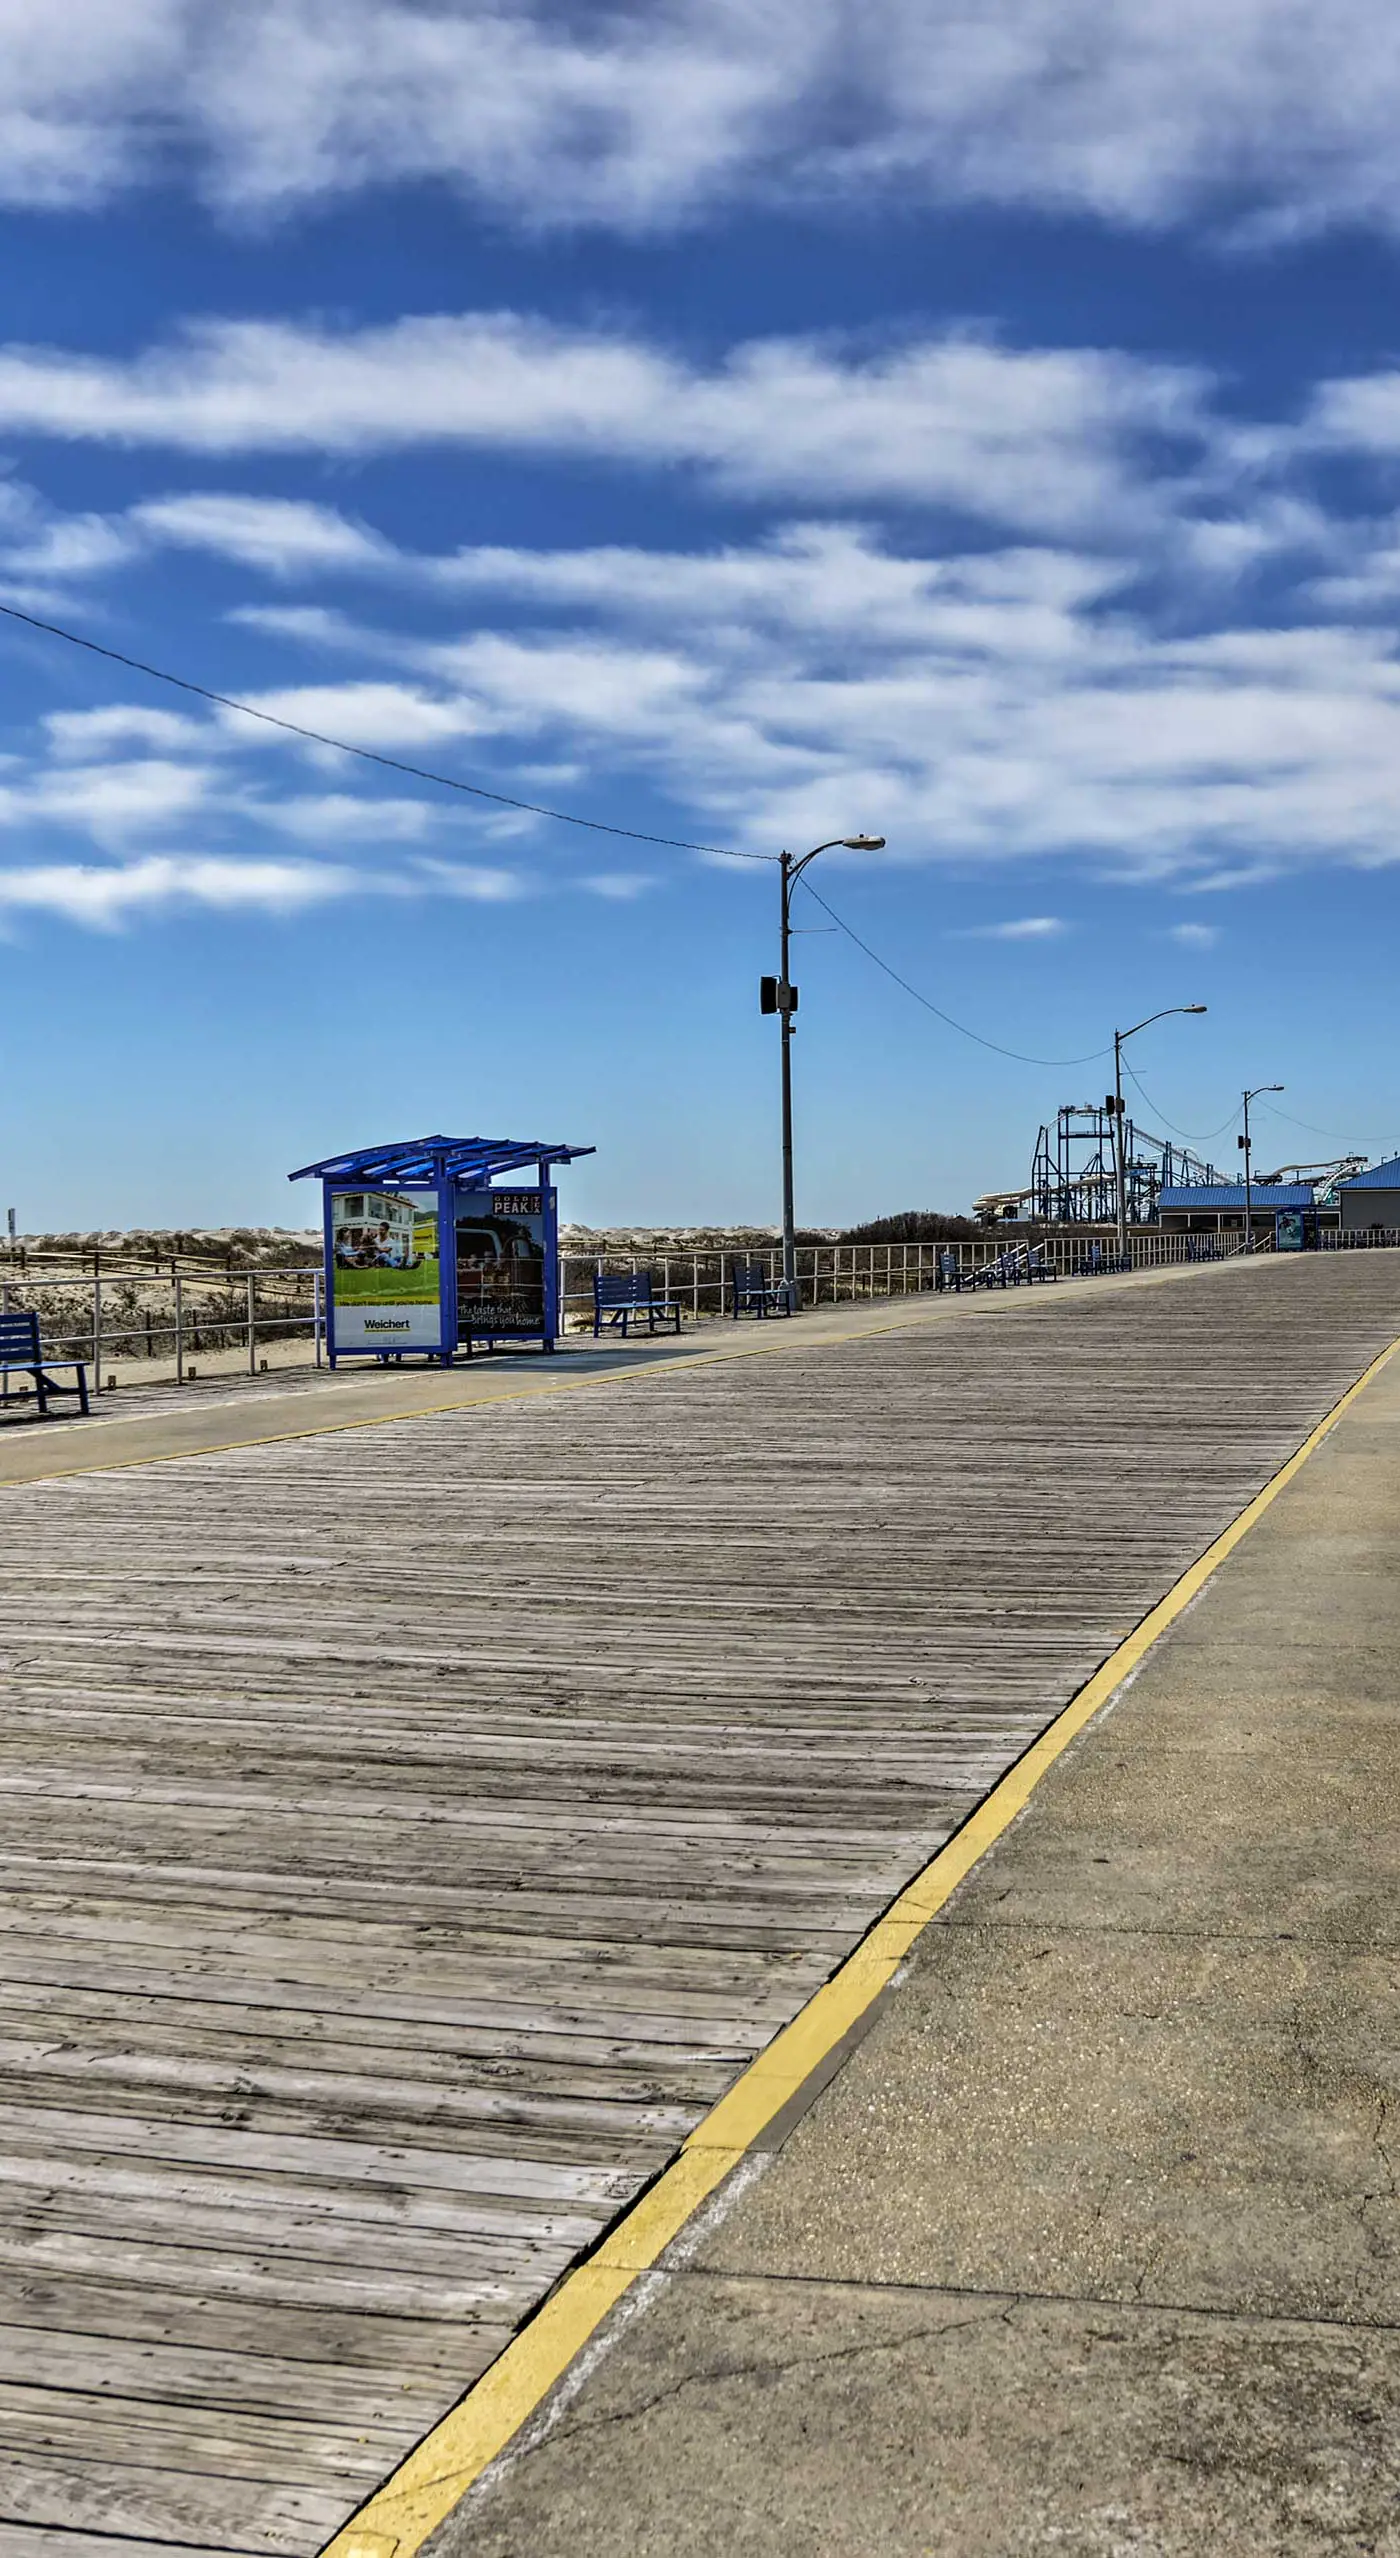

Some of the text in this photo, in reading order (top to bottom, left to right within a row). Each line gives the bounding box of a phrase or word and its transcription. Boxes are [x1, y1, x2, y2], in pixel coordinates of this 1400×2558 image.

[494, 1202, 529, 1213] PEAK
[473, 1304, 496, 1315] taste
[364, 1319, 410, 1328] Weichert
[499, 1317, 515, 1328] you
[516, 1312, 540, 1326] home
